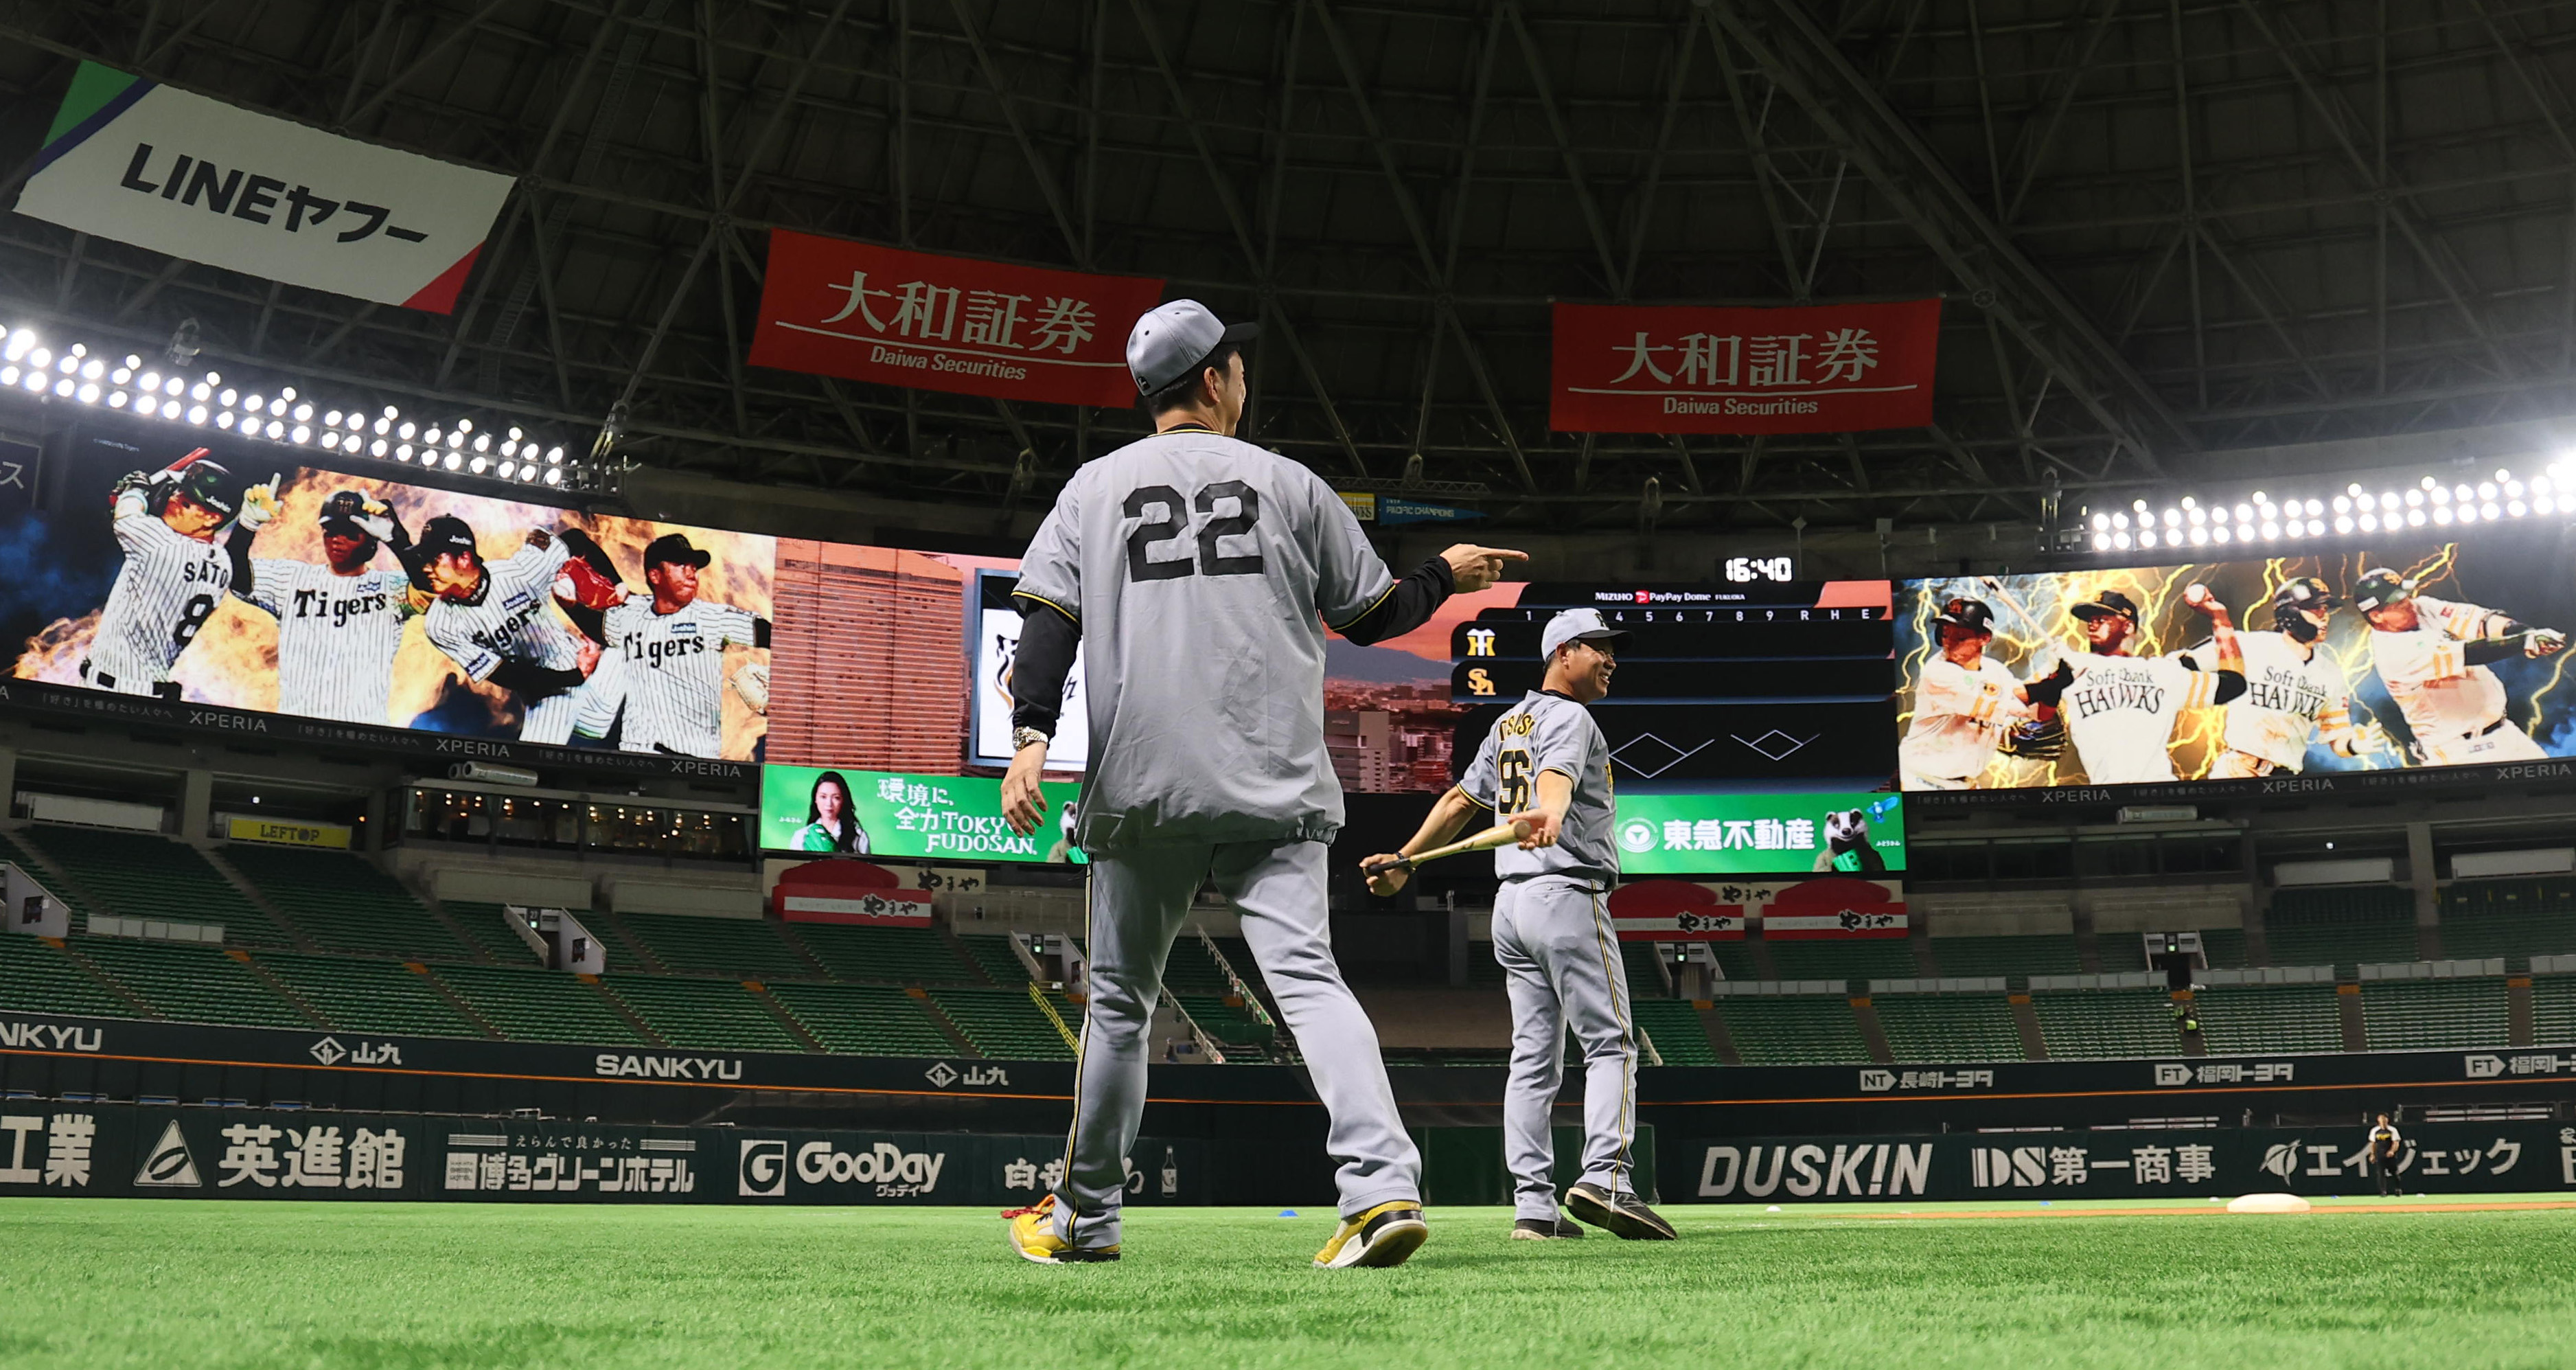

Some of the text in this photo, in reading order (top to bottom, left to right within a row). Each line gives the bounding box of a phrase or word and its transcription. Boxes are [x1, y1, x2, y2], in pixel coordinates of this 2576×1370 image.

[120, 143, 428, 244] LINEヤフー
[821, 271, 1096, 356] 大和証券
[870, 345, 1026, 381] Daiwa Securities
[1610, 328, 1878, 387] 大和証券
[1664, 398, 1818, 416] Daiwa Securities
[1123, 480, 1263, 582] 22
[184, 561, 229, 591] SATO
[1725, 558, 1792, 582] 16:40
[294, 589, 387, 628] Tigers
[505, 593, 529, 608] Joshin
[1595, 592, 1633, 601] MIZUHO
[1649, 592, 1682, 604] PayPay
[1684, 592, 1712, 602] Dome
[174, 594, 215, 647] 8
[1526, 609, 1870, 621] 1 4 5 6 7 8 9 R H E
[623, 631, 704, 669] Tigers
[2075, 683, 2165, 720] HAWKS
[189, 710, 267, 732] XPERIA
[436, 739, 510, 758] XPERIA
[671, 760, 742, 778] XPERIA
[2496, 763, 2573, 781] XPERIA
[1498, 749, 1531, 816] 96
[2262, 777, 2334, 795] XPERIA
[2042, 789, 2111, 803] XPERIA
[895, 806, 1016, 836] 全力TOKY
[1663, 819, 1815, 851] 東急不動産
[918, 869, 980, 891] やまや
[864, 893, 919, 916] やまや
[1723, 885, 1771, 903] やまや
[1678, 910, 1732, 933] やまや
[1839, 909, 1894, 932] やまや
[351, 1042, 402, 1065] 山九
[595, 1055, 742, 1080] SANKYU
[963, 1066, 1009, 1086] 山九
[2161, 1068, 2183, 1082] FT
[2197, 1063, 2294, 1084] 福岡トヨタ
[2472, 1059, 2494, 1074] FT
[1863, 1073, 1887, 1088] NT
[1900, 1070, 1994, 1089] 長崎トヨタ
[0, 1113, 96, 1187] 工業
[516, 1134, 632, 1151] えらんで良かった
[217, 1122, 406, 1189] 英進館
[2050, 1143, 2216, 1187] 第一商事
[479, 1151, 694, 1194] 博多グリーンホテル
[796, 1141, 945, 1194] GooDay
[876, 1185, 919, 1198] グッデイ
